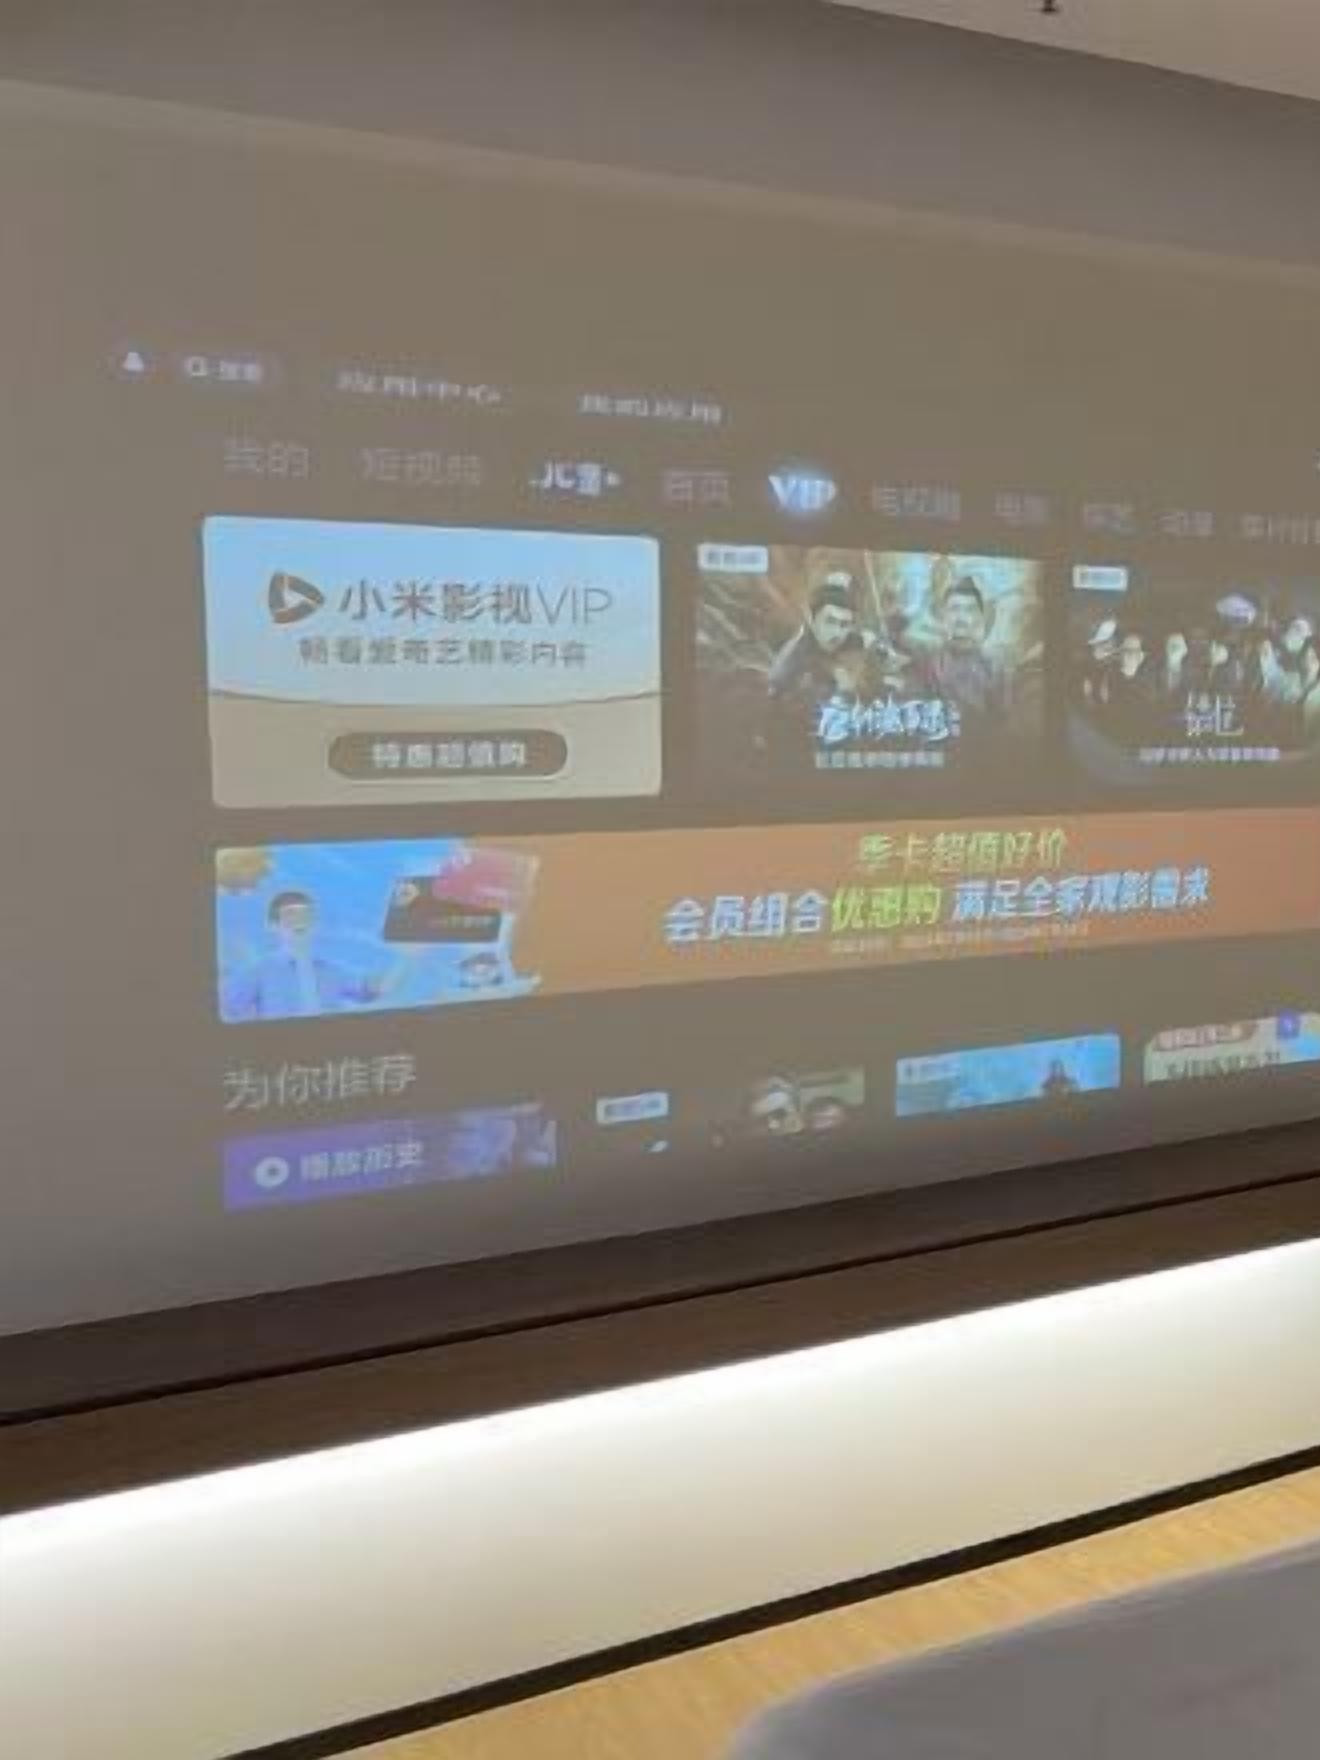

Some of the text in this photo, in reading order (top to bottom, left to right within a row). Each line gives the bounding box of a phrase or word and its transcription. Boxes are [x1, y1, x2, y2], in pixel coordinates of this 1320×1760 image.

[768, 472, 837, 510] VIP
[338, 579, 614, 626] 小米影视VIP
[224, 1053, 417, 1110] 为你推荐
